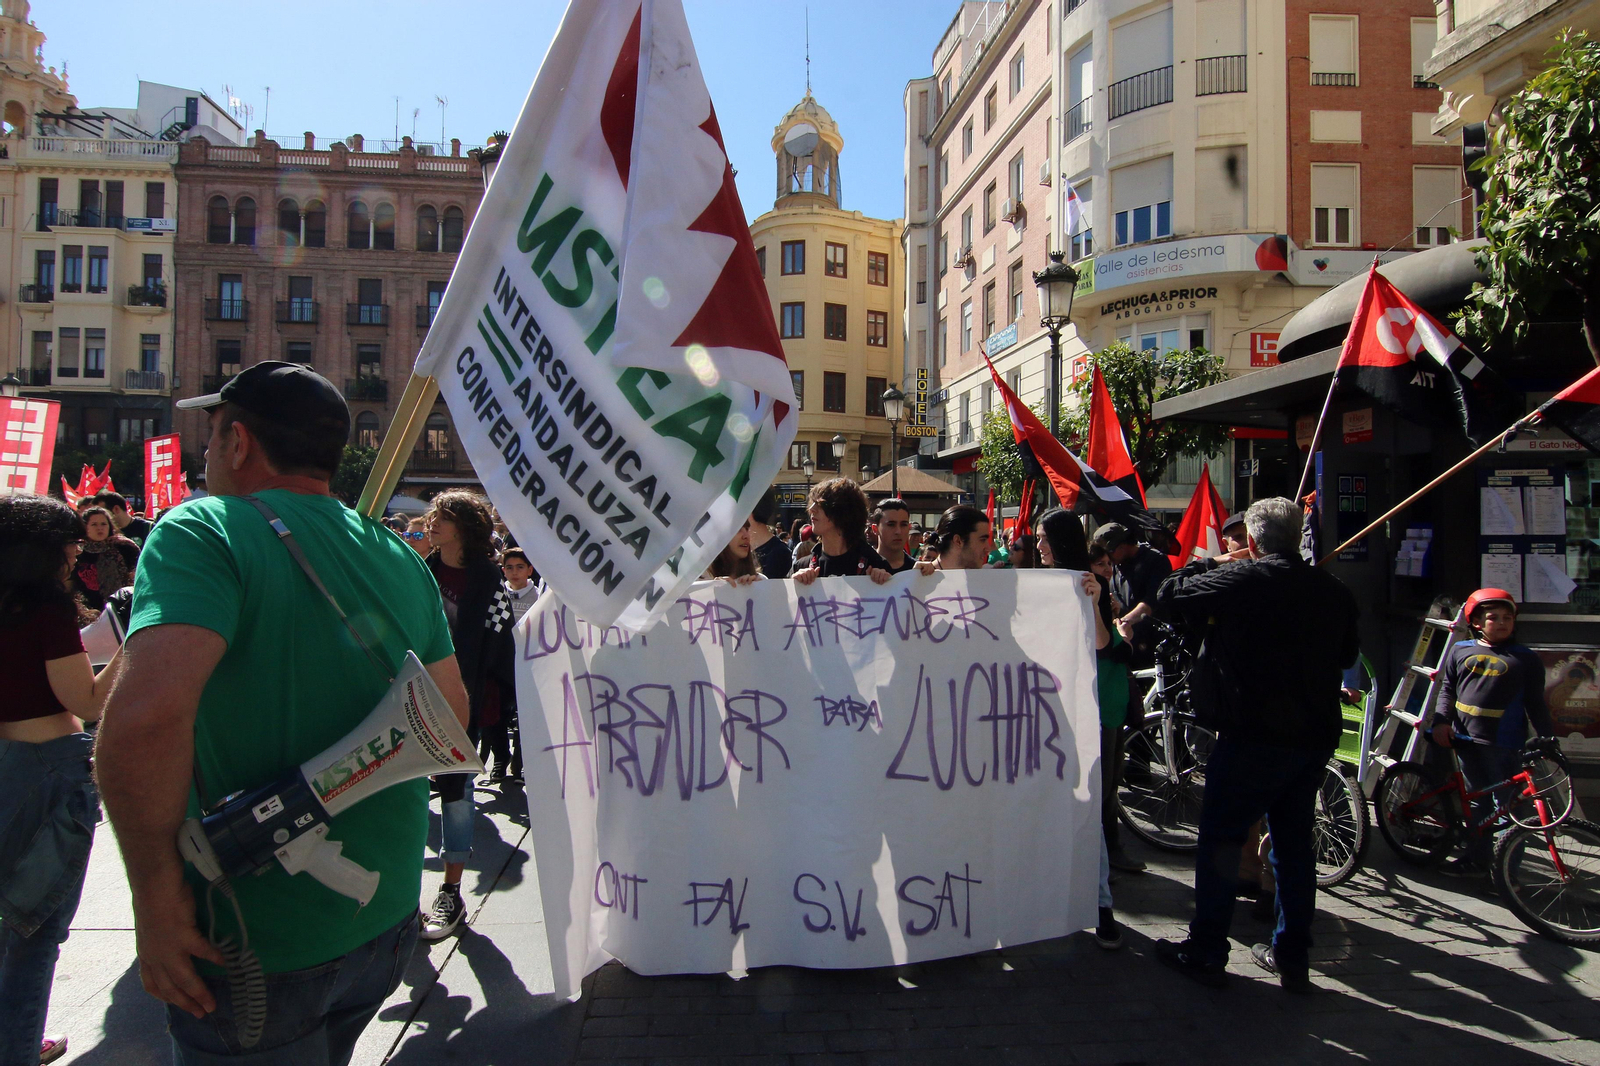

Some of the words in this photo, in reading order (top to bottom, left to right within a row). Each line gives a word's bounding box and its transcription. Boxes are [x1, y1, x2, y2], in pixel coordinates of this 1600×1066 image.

[1094, 260, 1123, 276] Valle
[1128, 254, 1148, 268] de
[1153, 244, 1225, 263] ledesma
[1126, 262, 1184, 280] asistencias
[1101, 287, 1217, 316] LECHUGA&PRIOR
[1115, 300, 1196, 321] ABOGADOS
[1409, 371, 1436, 389] AIT
[493, 265, 671, 528] INTERSINDICAL
[917, 369, 928, 425] HOTEL
[906, 426, 937, 437] BOSTON
[1529, 441, 1537, 449] El
[1539, 441, 1560, 449] Gato
[457, 346, 625, 596] CONFEDERACIÓN
[512, 376, 650, 561] ANDALUZA
[675, 597, 760, 653] PARA
[783, 587, 999, 650] APRENDER
[404, 702, 420, 735] INTERINO
[542, 671, 790, 801] APRENDER
[813, 694, 883, 732] PARA
[886, 662, 1066, 791] LUCHAR
[421, 730, 441, 752] ACCESO
[594, 861, 648, 920] CNT
[898, 863, 982, 938] SAT
